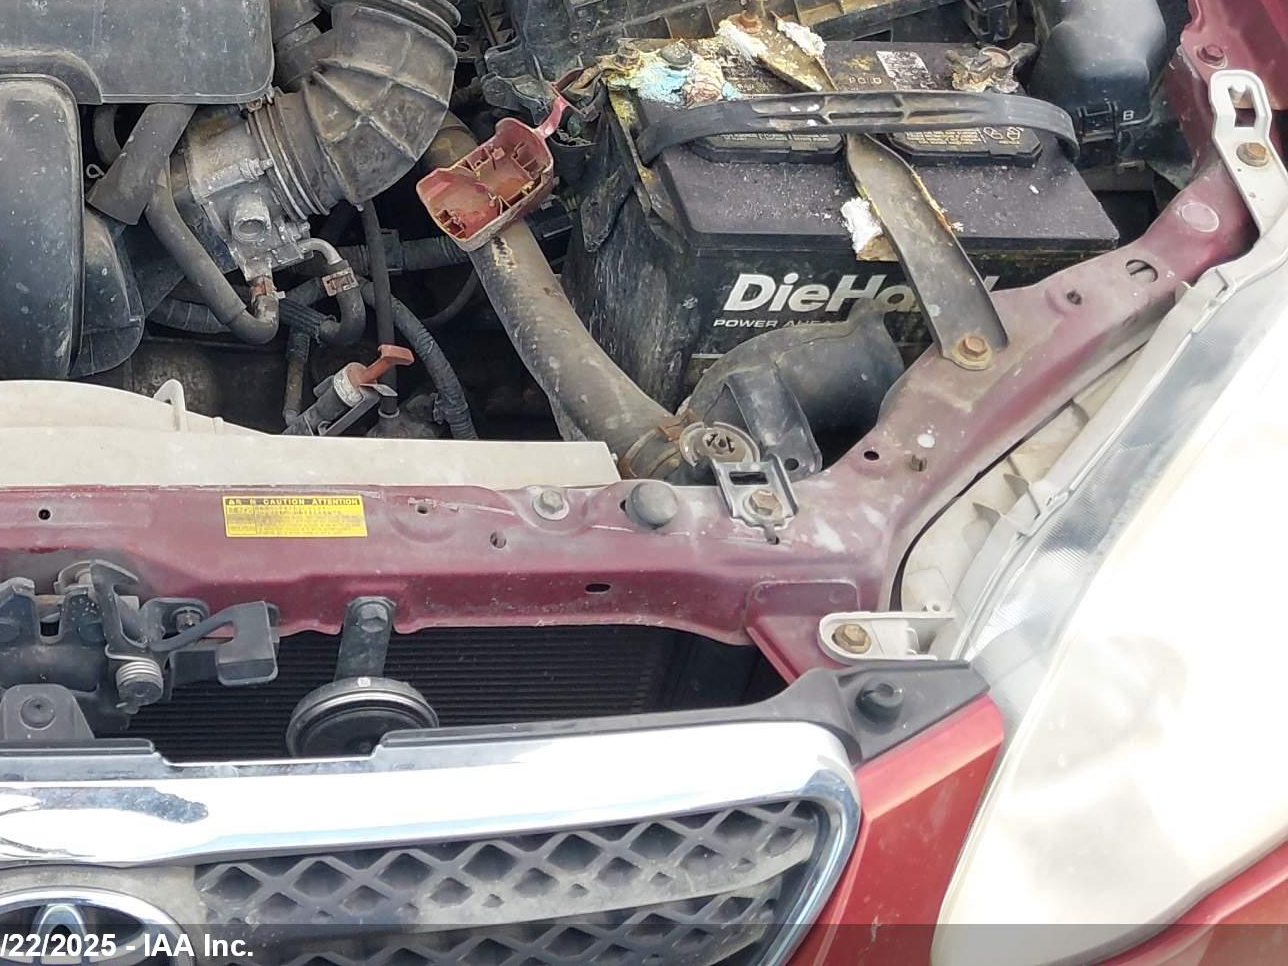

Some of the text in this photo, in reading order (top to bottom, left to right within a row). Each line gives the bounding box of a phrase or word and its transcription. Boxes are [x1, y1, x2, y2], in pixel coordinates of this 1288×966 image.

[722, 272, 1000, 313] DieHa
[713, 319, 778, 328] POWER
[312, 498, 359, 506] ATTENTION
